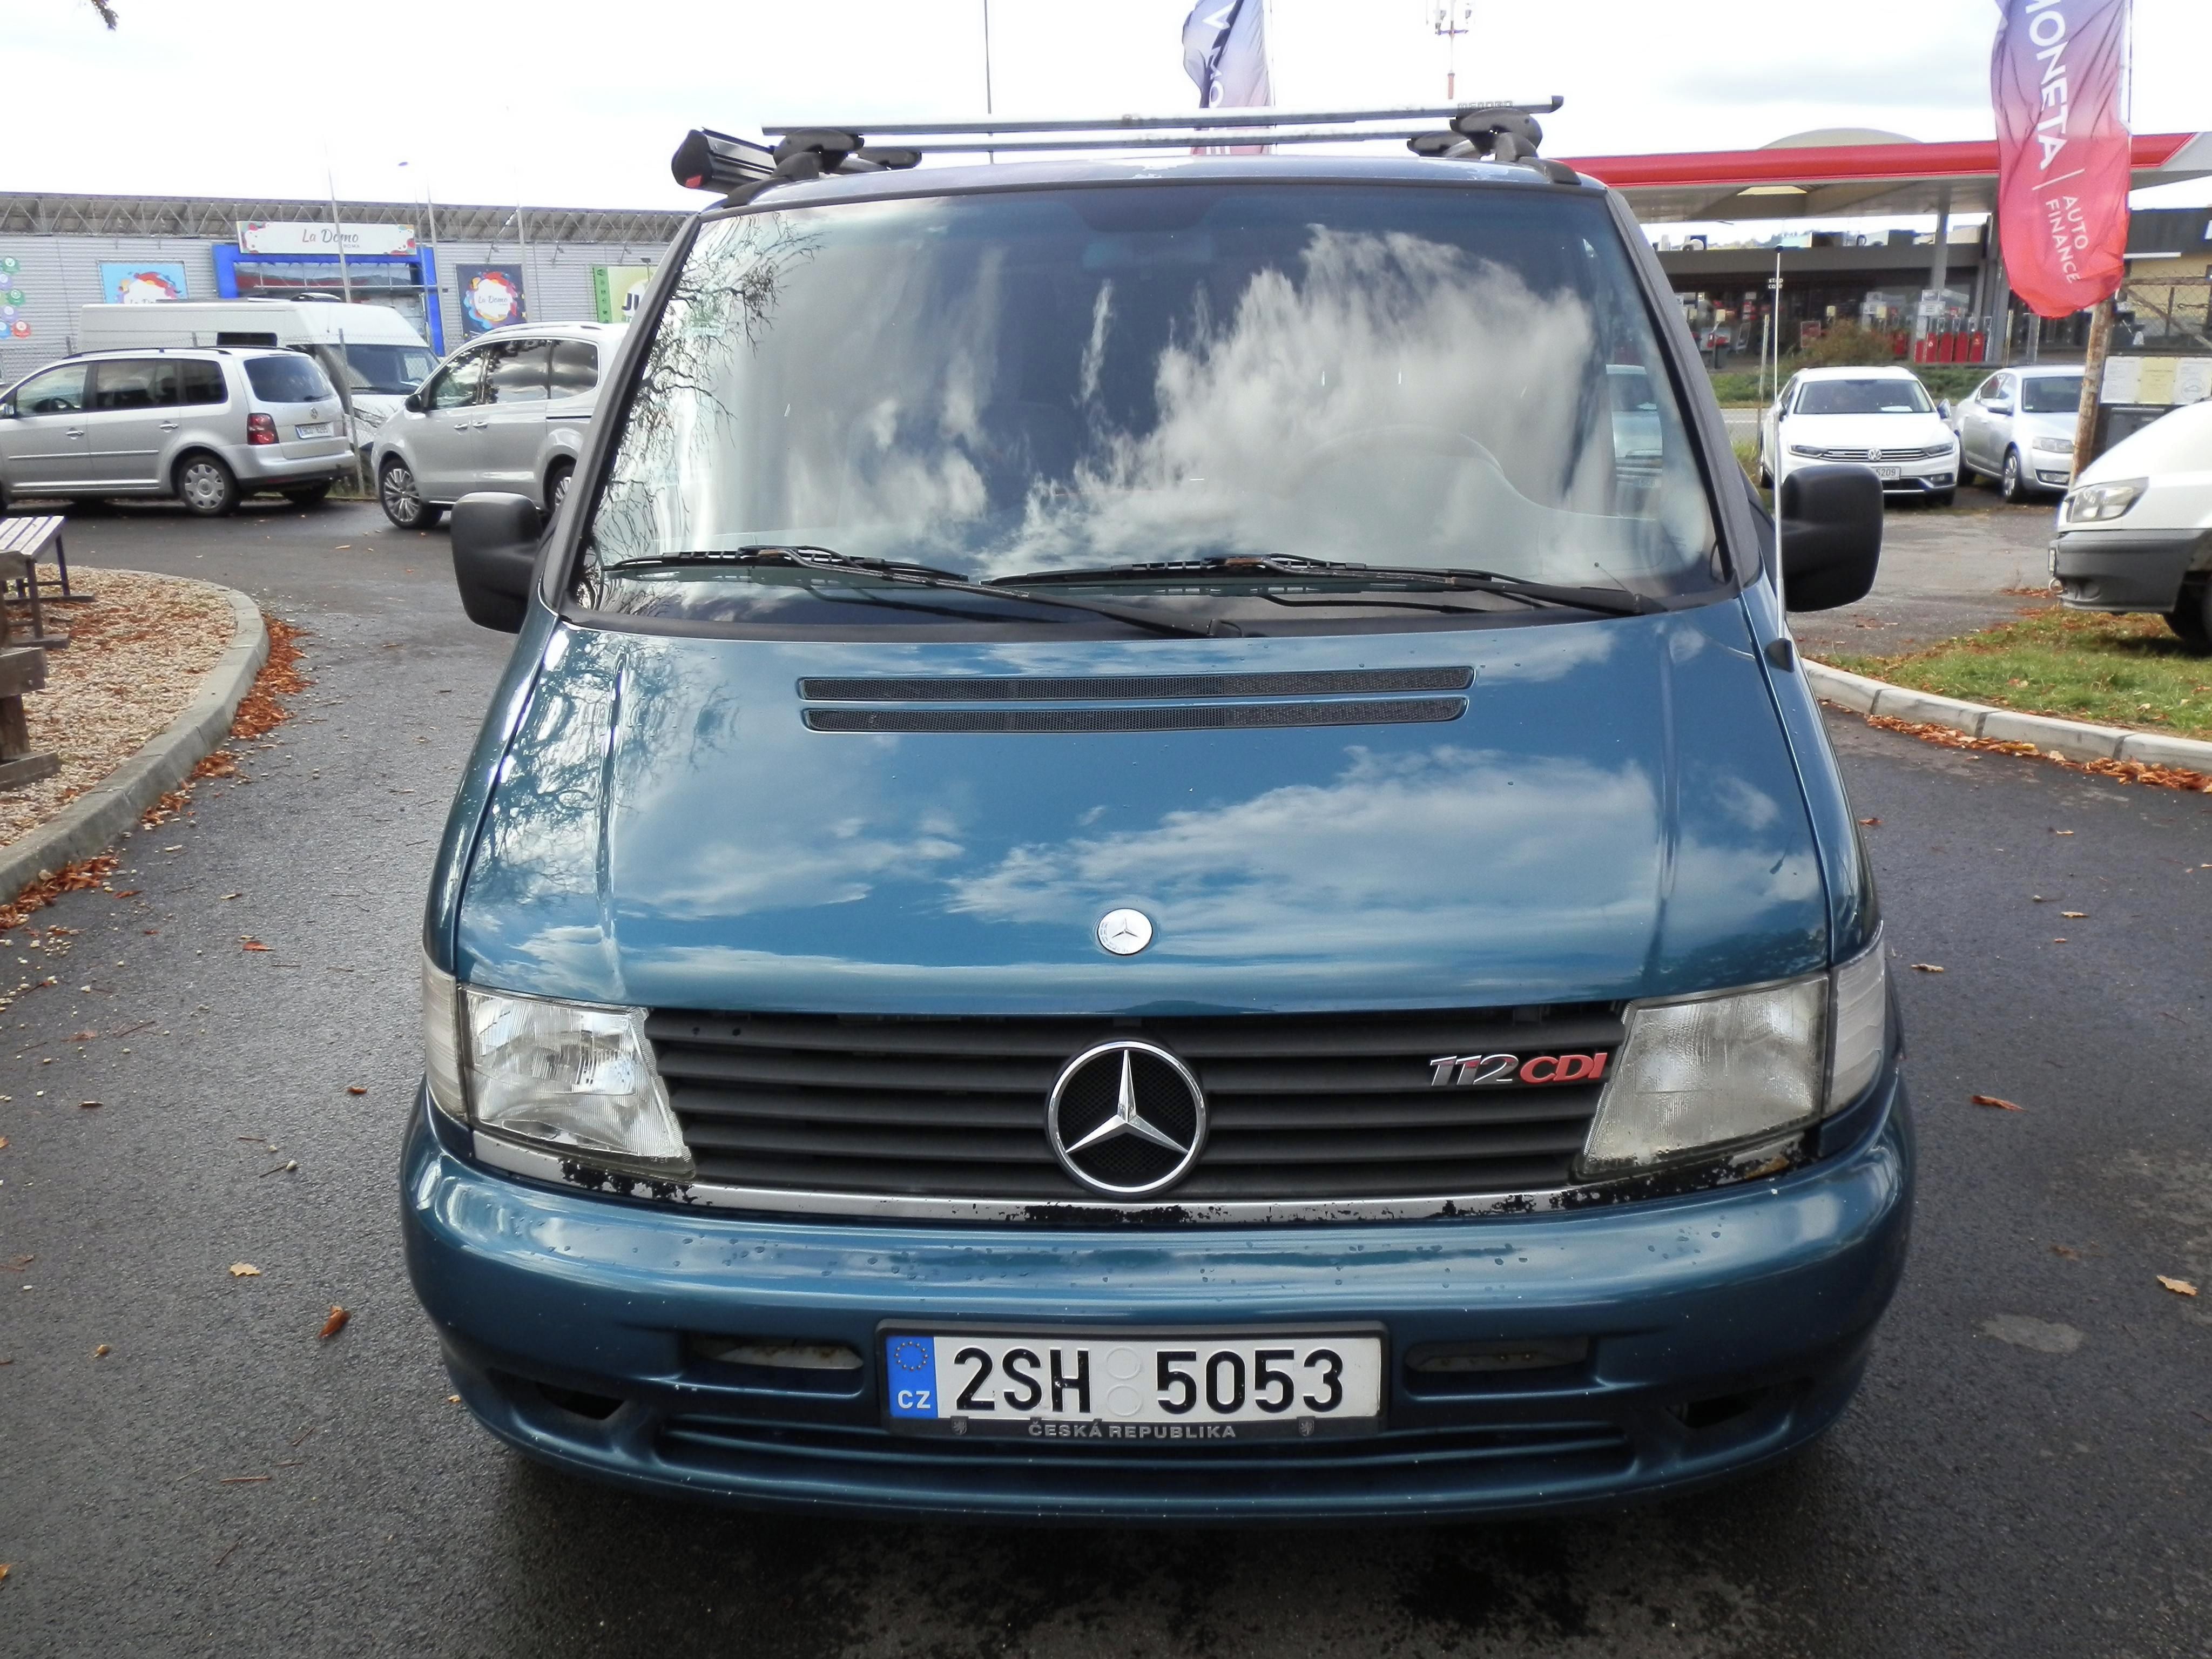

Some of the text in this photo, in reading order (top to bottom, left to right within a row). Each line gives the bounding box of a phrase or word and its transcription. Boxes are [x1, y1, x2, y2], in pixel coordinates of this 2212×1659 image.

[302, 228, 316, 242] La
[2062, 196, 2088, 249] AUTO
[2045, 198, 2081, 284] FINANCE
[1429, 1052, 1608, 1087] 112 CDI
[954, 1345, 1344, 1414] 2SH 5053
[898, 1390, 931, 1409] CZ
[1028, 1421, 1236, 1439] ČESKÁ REPUBLIKA
